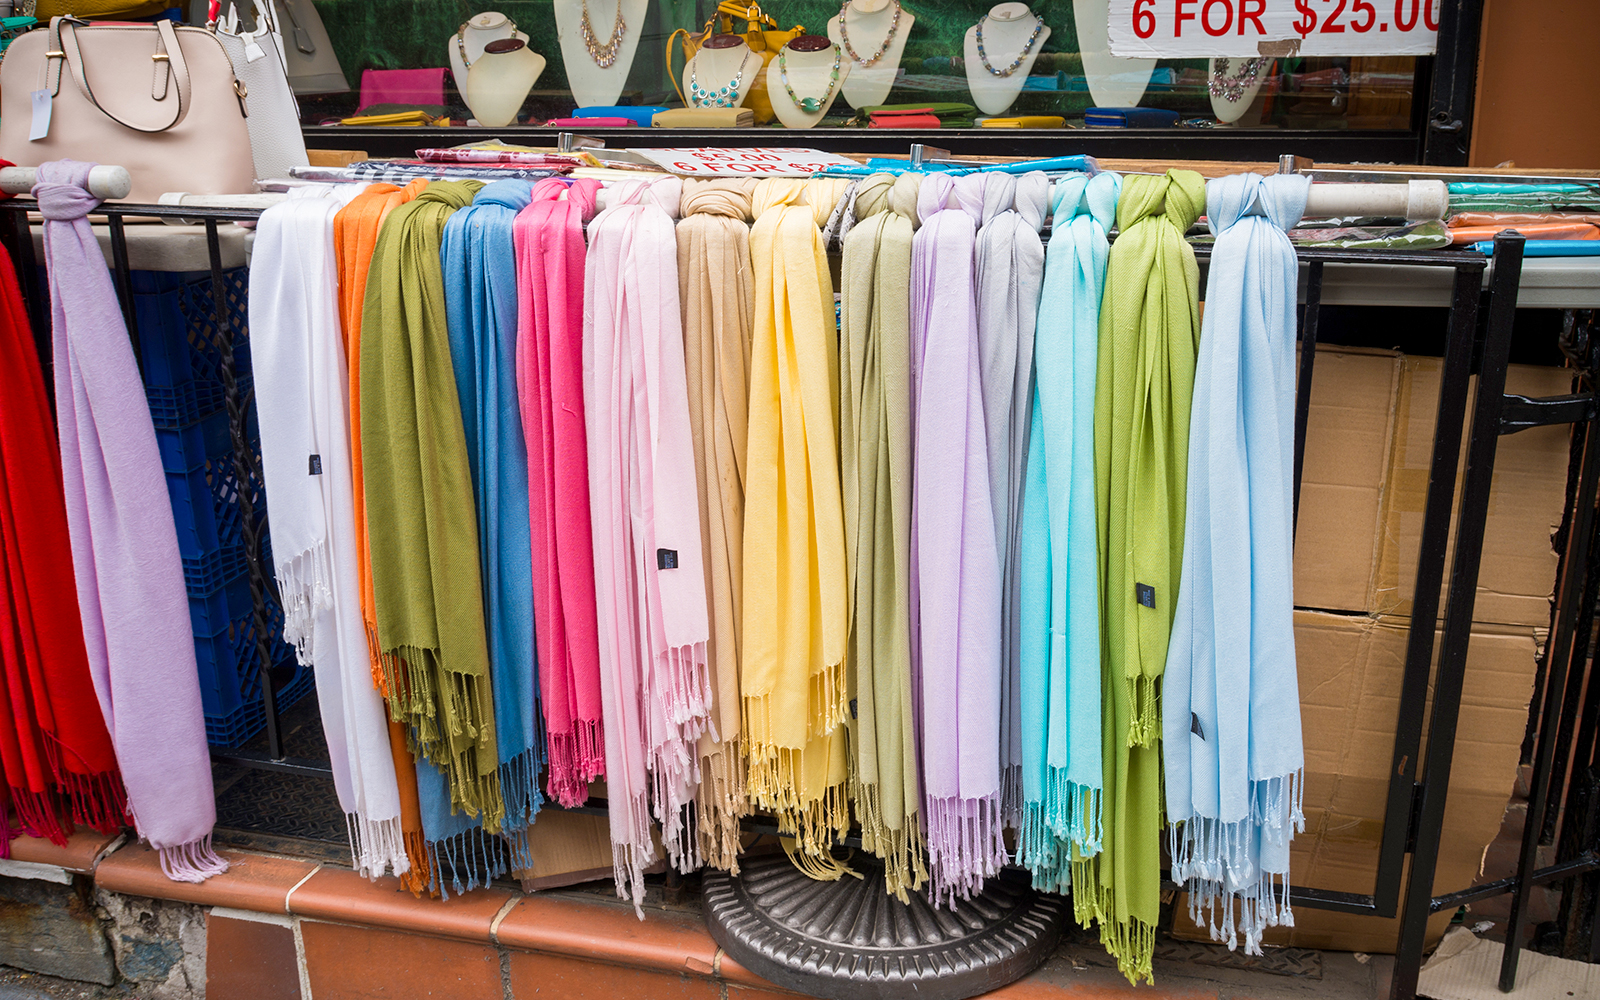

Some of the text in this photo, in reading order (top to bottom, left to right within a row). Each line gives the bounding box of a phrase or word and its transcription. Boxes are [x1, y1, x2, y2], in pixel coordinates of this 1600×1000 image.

[1132, 0, 1156, 38] 6
[1174, 0, 1267, 37] FOR
[691, 153, 783, 162] $5.00
[673, 161, 698, 171] 6
[701, 162, 787, 173] FOR
